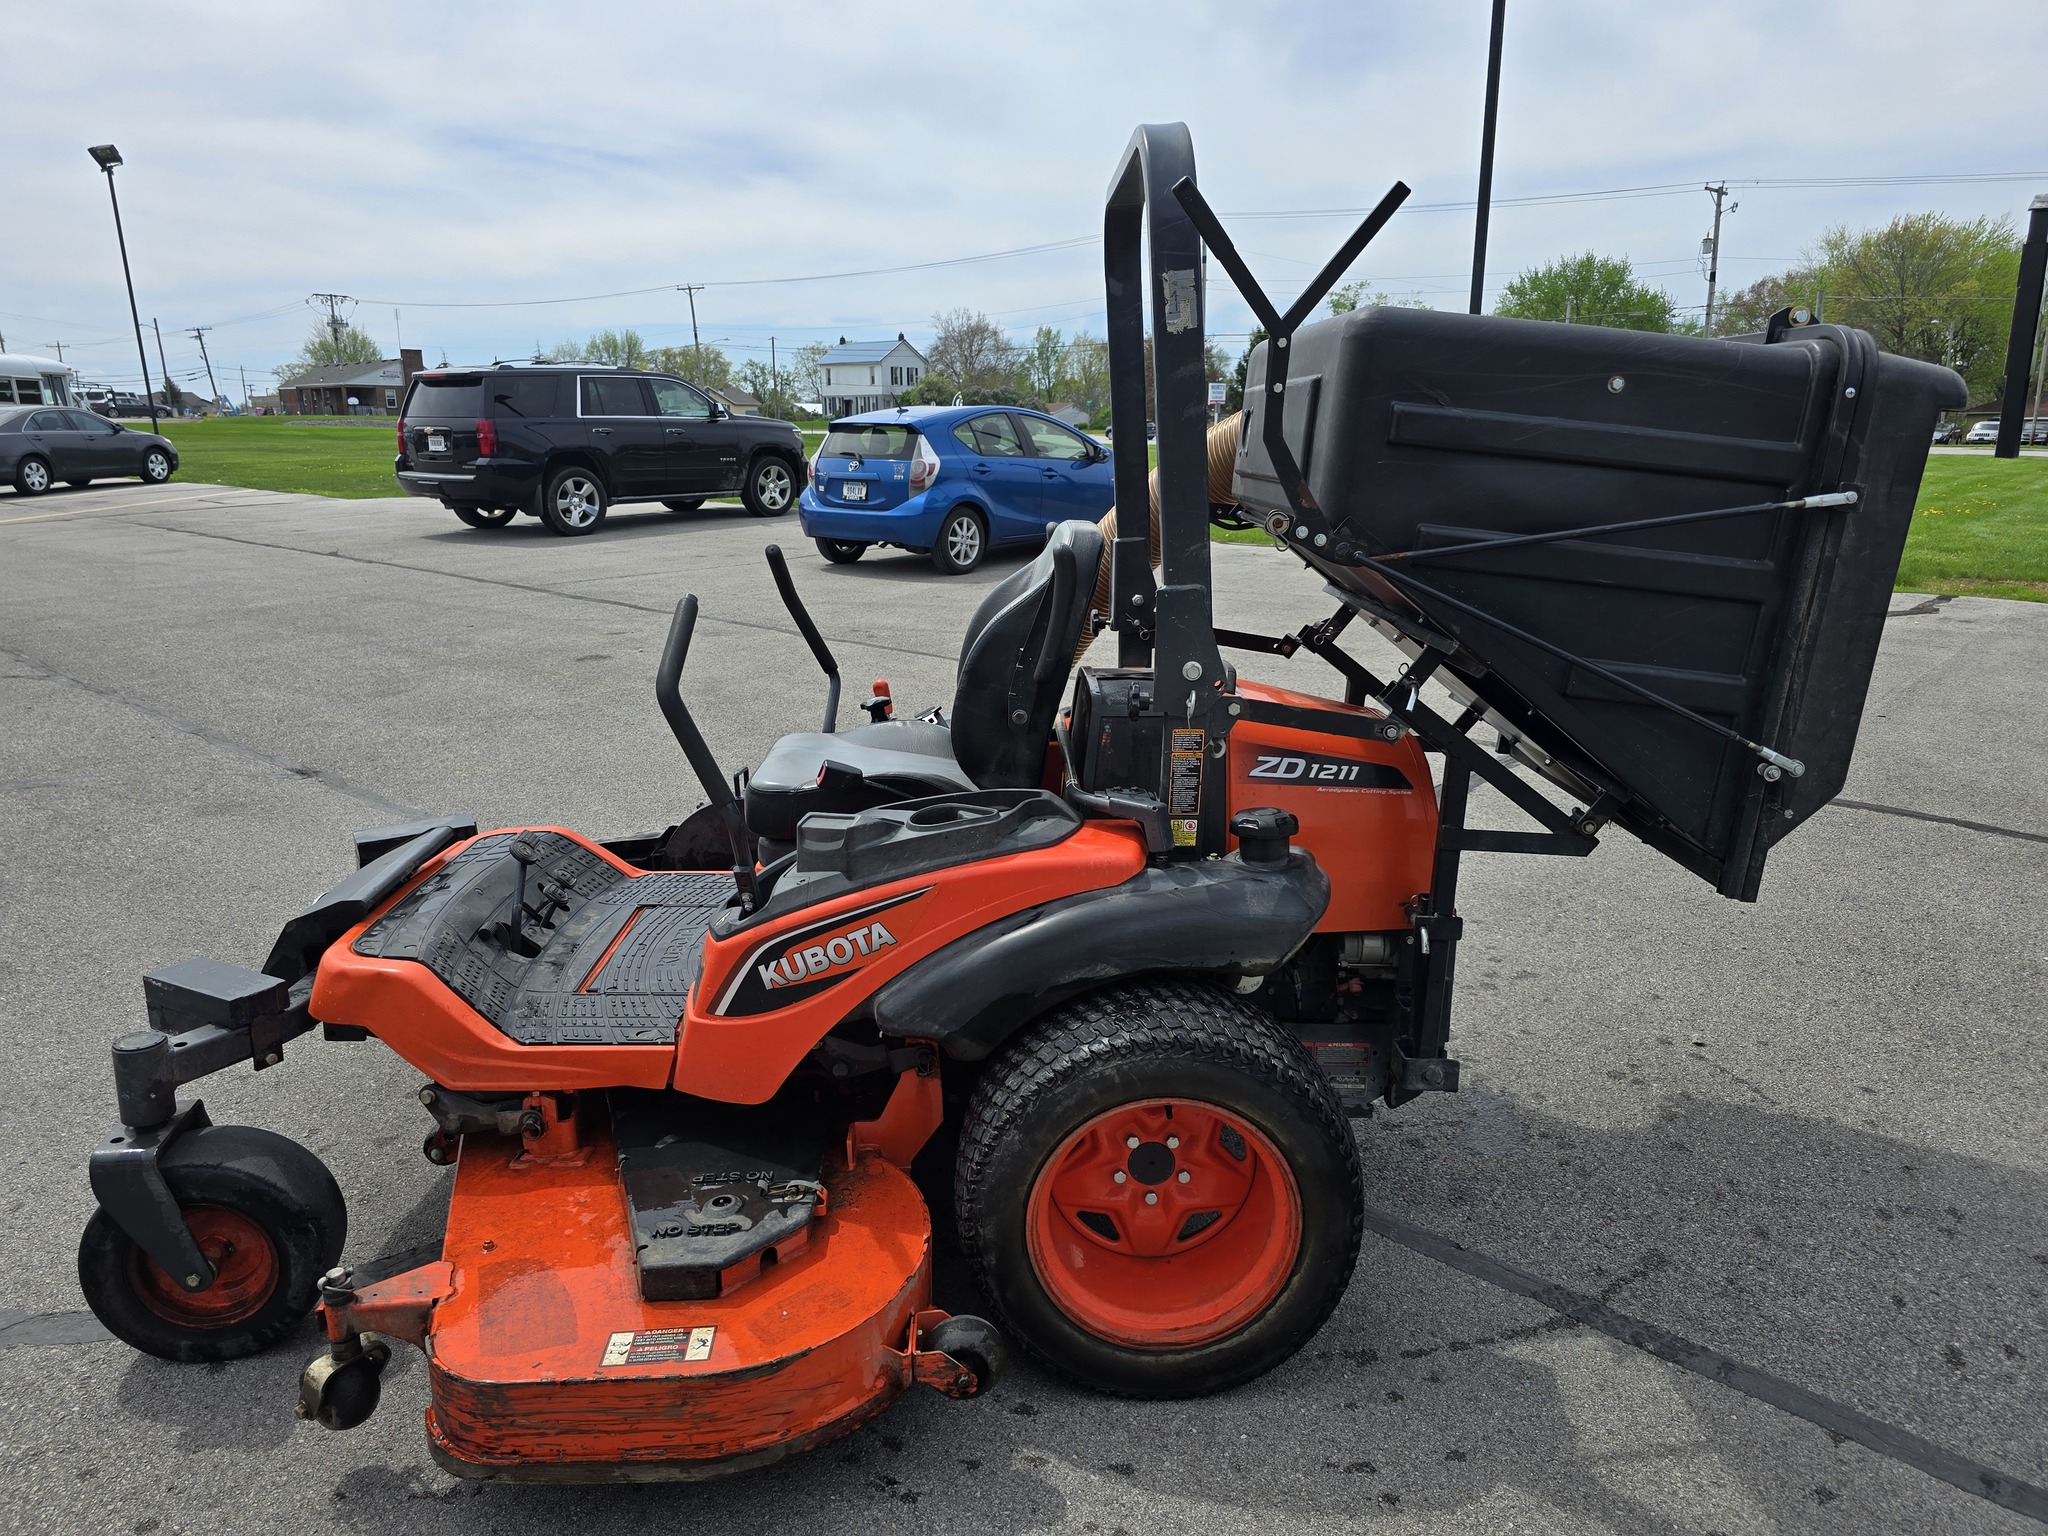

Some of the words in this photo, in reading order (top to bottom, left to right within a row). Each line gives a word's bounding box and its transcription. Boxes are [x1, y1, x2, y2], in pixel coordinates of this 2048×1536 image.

[1248, 755, 1307, 779] ZD
[1308, 763, 1360, 781] 1211
[1316, 786, 1360, 794] Aerodynamic
[1361, 787, 1387, 795] Cutting
[757, 921, 898, 991] KUBOTA
[691, 1171, 741, 1185] STEP
[651, 1226, 683, 1239] NO
[687, 1222, 742, 1237] STEP
